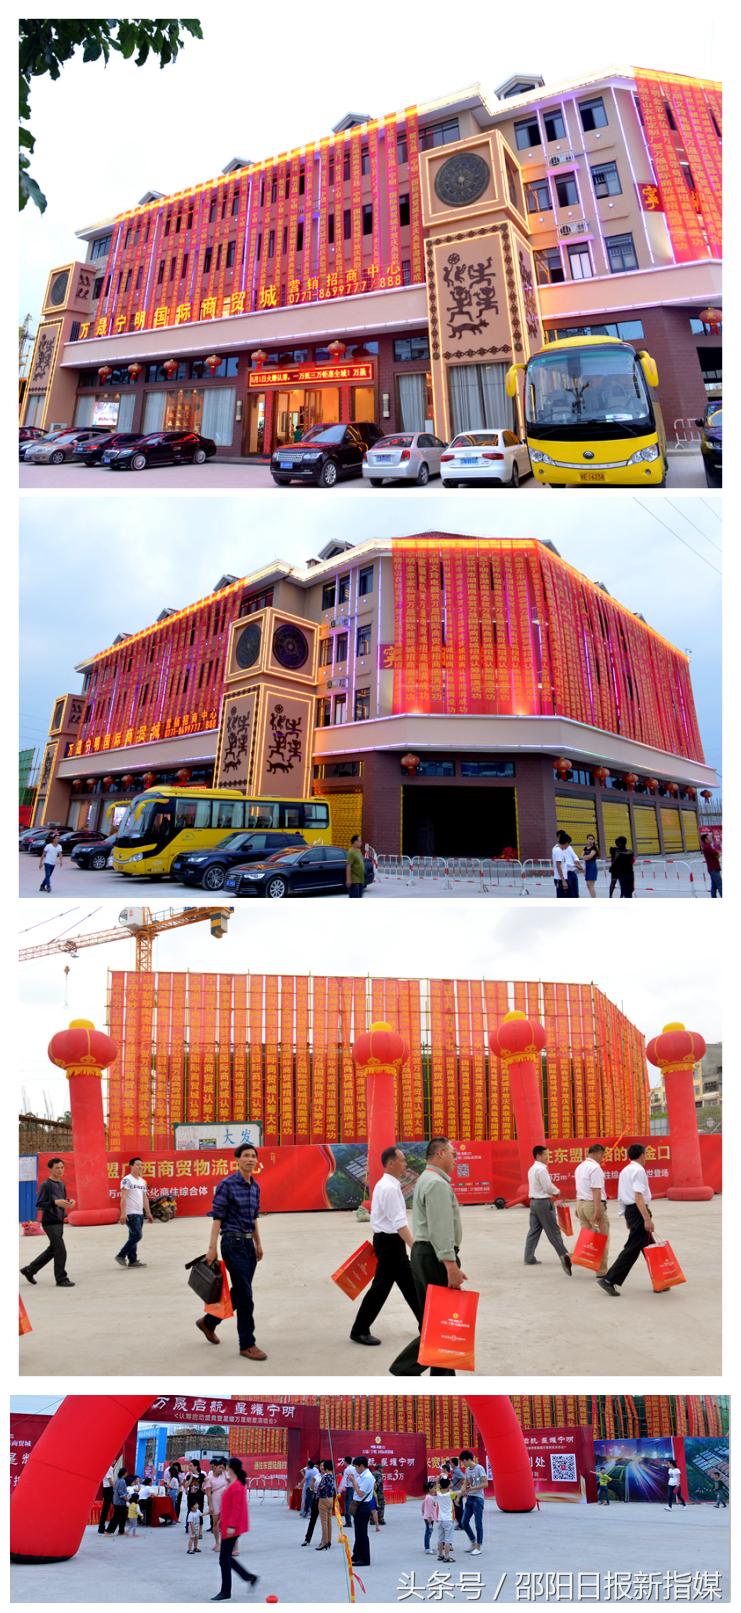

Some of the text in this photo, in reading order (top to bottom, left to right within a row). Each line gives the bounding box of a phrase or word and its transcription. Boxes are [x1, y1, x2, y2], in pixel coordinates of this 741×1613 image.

[288, 261, 400, 293] 营销招商中心
[79, 284, 278, 339] 万晟宁明国际商贸城
[152, 1396, 296, 1418] 万晟启航 星耀宁明
